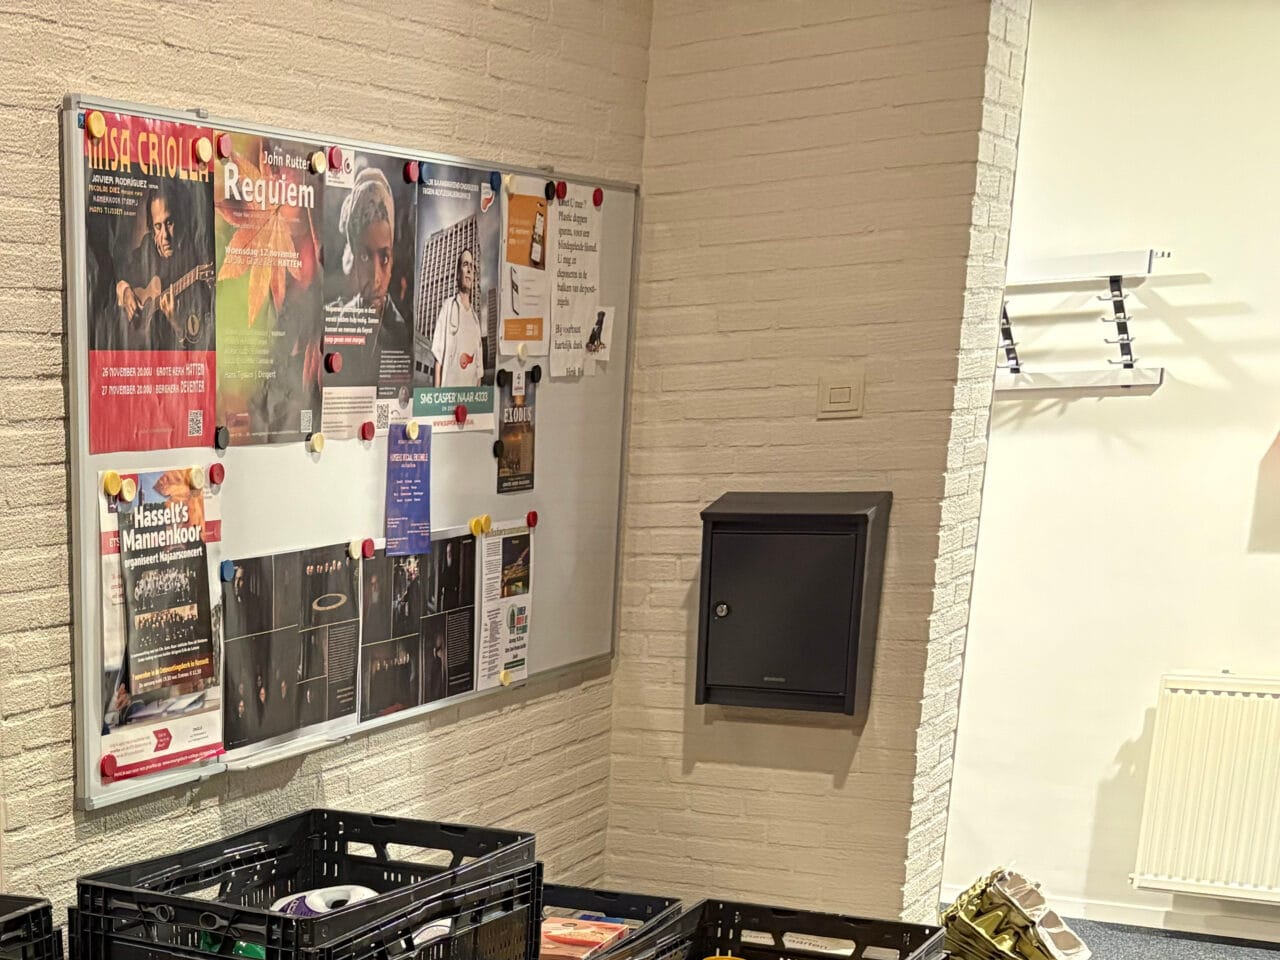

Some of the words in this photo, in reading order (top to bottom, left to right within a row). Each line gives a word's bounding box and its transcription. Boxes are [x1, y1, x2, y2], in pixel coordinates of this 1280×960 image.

[263, 151, 283, 167] John
[286, 154, 310, 170] Rutter
[92, 175, 114, 184] JAVIER
[224, 161, 314, 210] Requiem
[110, 367, 136, 377] NOVEMBER
[185, 363, 205, 376] HATTEM
[108, 385, 136, 395] NOVEMBER
[180, 380, 205, 393] DEVENTER
[420, 393, 433, 404] SMS
[456, 392, 474, 402] NAAR
[504, 407, 532, 423] EXODUS
[134, 502, 189, 529] Hasselt's
[122, 524, 202, 552] Mannenkoor
[124, 553, 159, 570] organiseert
[160, 547, 203, 564] Najaarsconcert
